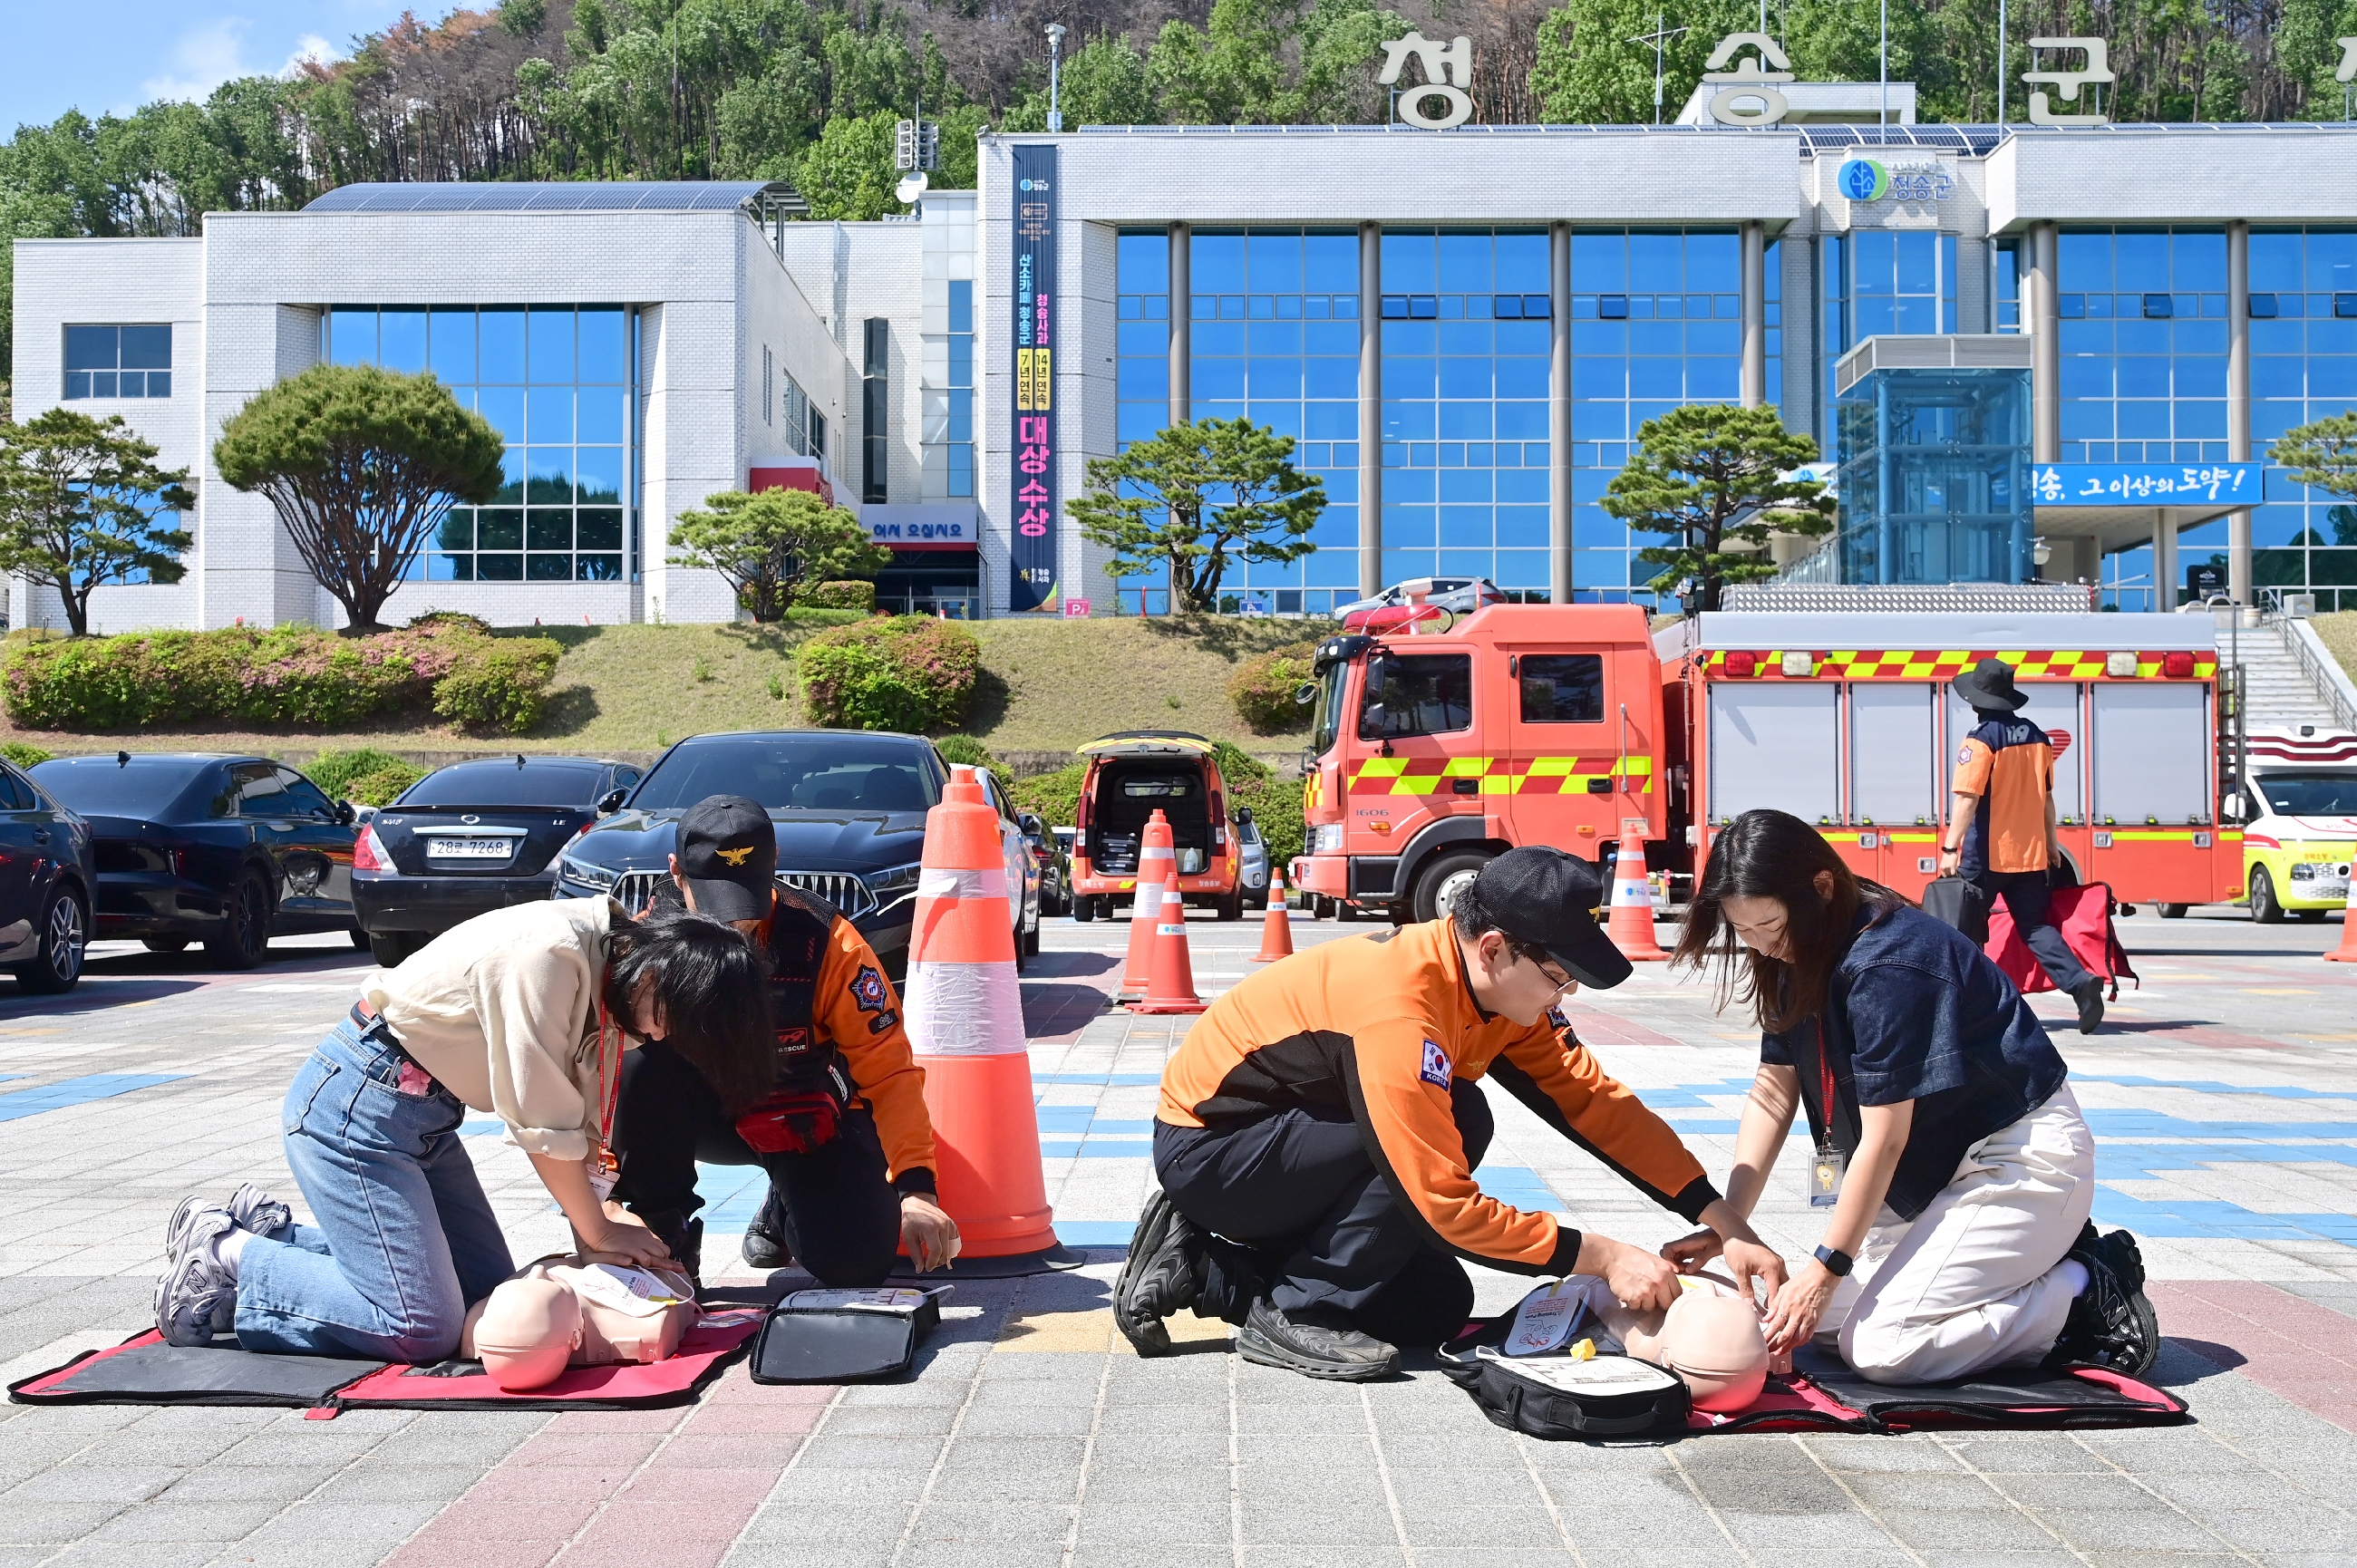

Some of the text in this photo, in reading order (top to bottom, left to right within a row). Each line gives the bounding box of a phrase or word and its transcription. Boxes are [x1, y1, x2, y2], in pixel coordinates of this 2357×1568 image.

[1892, 175, 1951, 199] 청송군
[1019, 254, 1032, 344] 산소카페 청송군
[1036, 294, 1049, 344] 청송사과
[1020, 354, 1030, 405] 7년 연속
[1035, 354, 1048, 405] 14년 연속
[1019, 416, 1050, 537] 대상 수상
[2079, 478, 2105, 496] 그
[2177, 466, 2245, 500] 도약!
[873, 524, 962, 538] 어서 오십시오
[2005, 724, 2030, 743] 119
[437, 841, 503, 854] 28로 7268
[1426, 1072, 1447, 1088] KOREA
[2100, 1293, 2127, 1330] N
